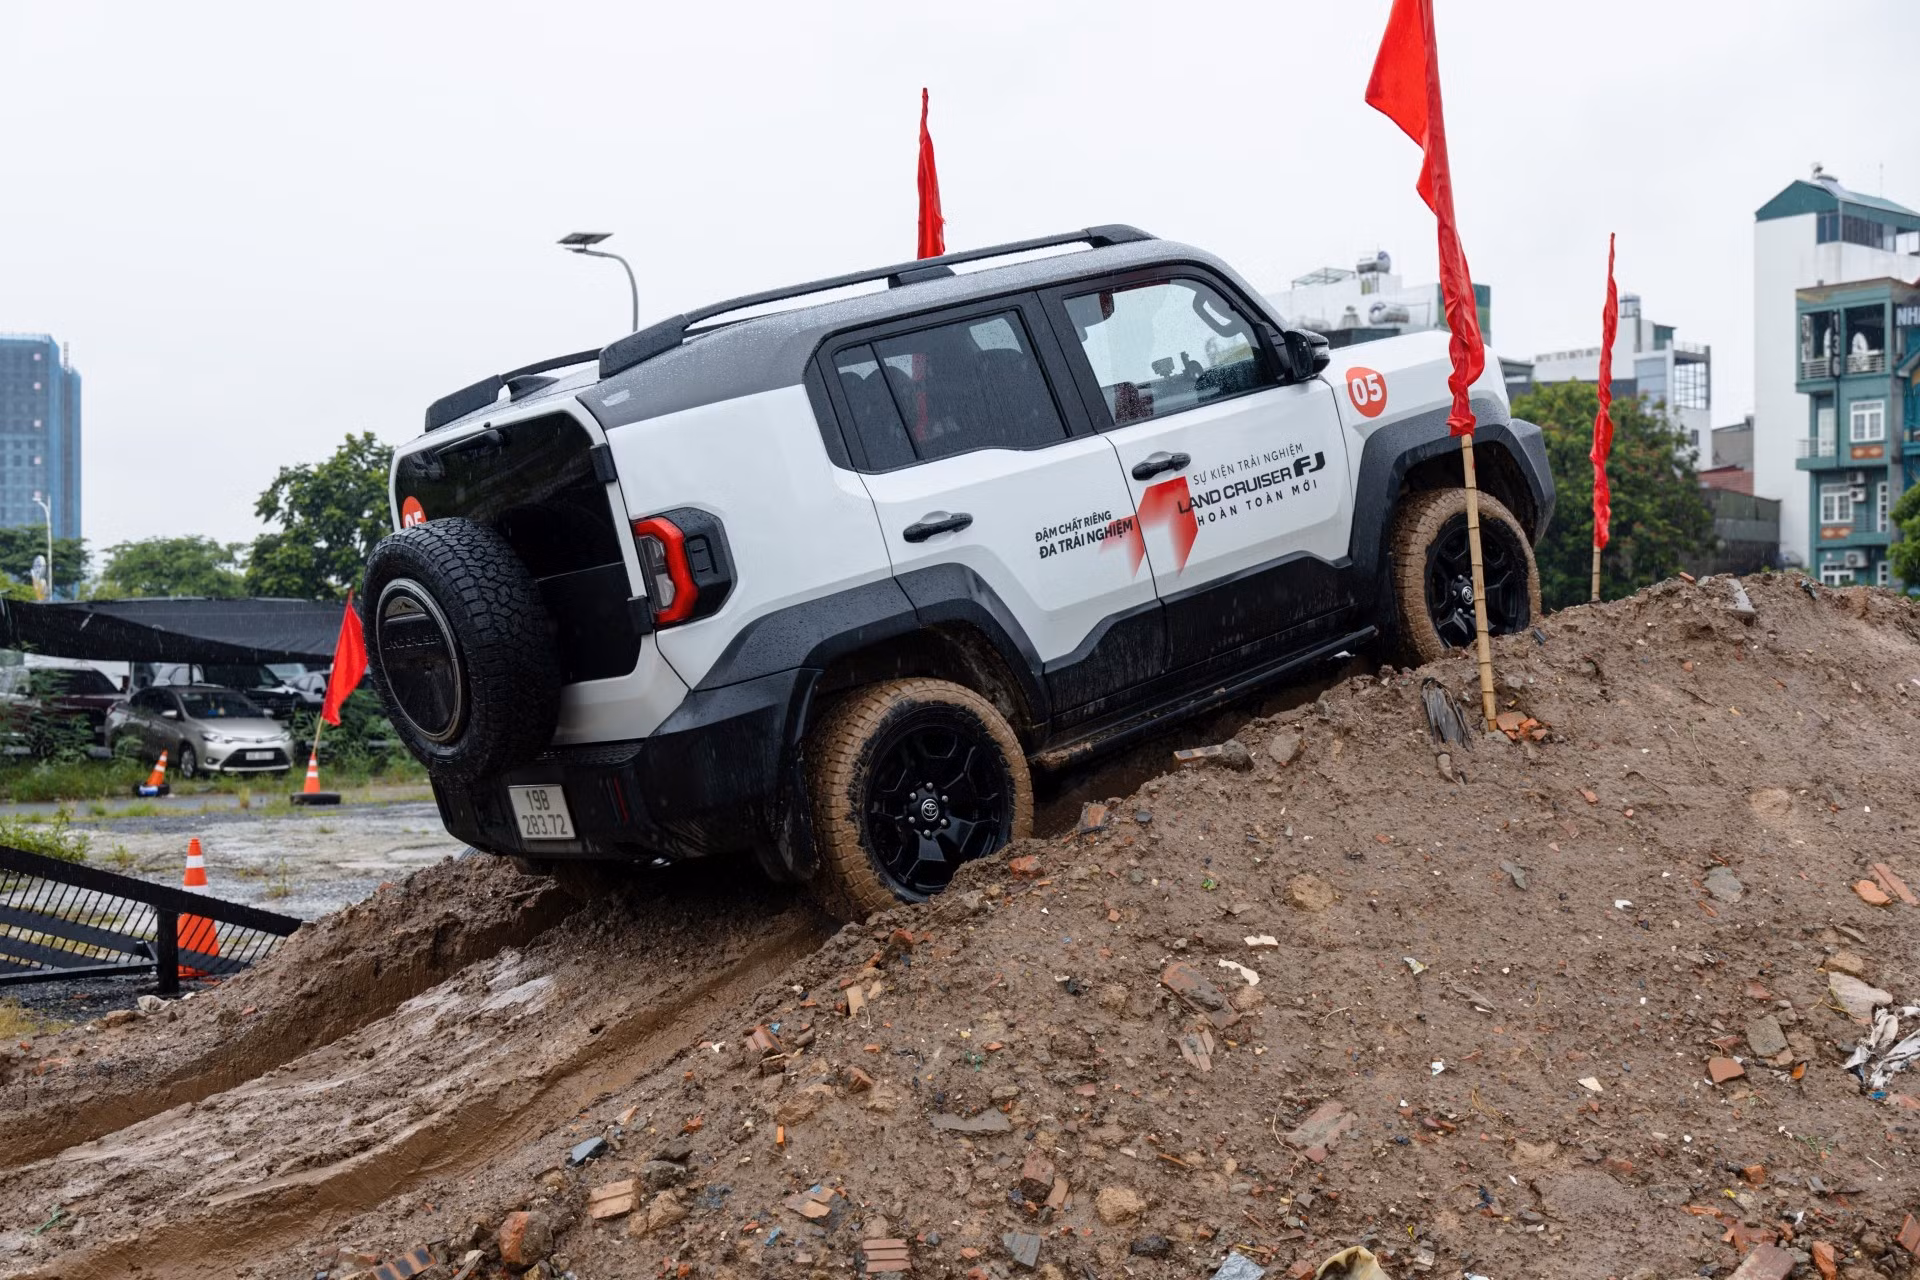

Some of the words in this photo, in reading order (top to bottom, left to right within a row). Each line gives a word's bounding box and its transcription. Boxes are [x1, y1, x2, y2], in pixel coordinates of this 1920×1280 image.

[1896, 306, 1920, 326] NH
[1351, 373, 1383, 406] 05
[1193, 470, 1207, 486] SỰ
[1210, 464, 1235, 480] KIỆN
[1237, 454, 1261, 472] TRẢI
[1263, 443, 1304, 463] NGHIỆM
[1177, 489, 1222, 514] LAND
[1223, 467, 1293, 500] CRUISER
[1293, 451, 1326, 478] FJ
[1197, 505, 1238, 527] HOÀN
[1246, 490, 1284, 511] TOÀN
[1291, 479, 1317, 496] MỚI
[1035, 527, 1058, 543] ĐẬM
[1058, 516, 1082, 535] CHẤT
[1084, 510, 1112, 527] RIÊNG
[1039, 543, 1057, 559] ĐA
[1058, 531, 1085, 553] TRẢI
[1086, 519, 1133, 545] NGHIỆM
[526, 789, 550, 811] 19B
[522, 813, 568, 836] 283.72
